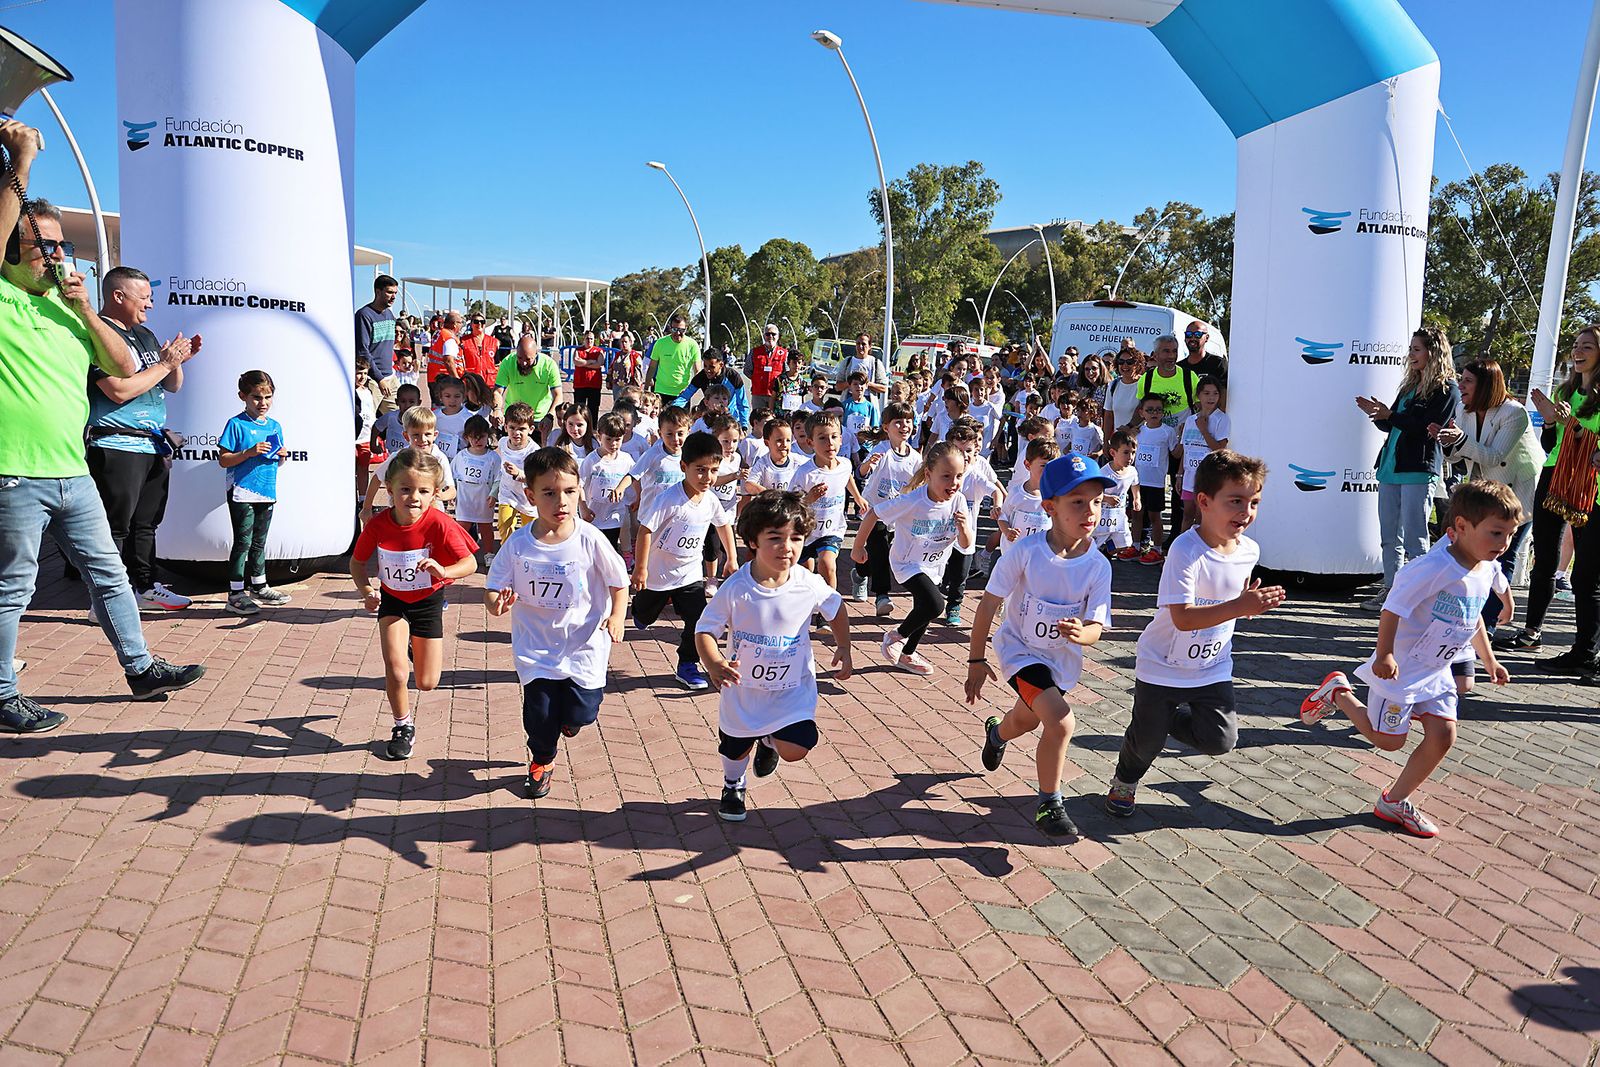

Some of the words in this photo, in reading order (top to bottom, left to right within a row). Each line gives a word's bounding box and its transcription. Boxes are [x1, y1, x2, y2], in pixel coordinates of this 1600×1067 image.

[165, 117, 244, 135] Fundación
[163, 133, 242, 150] ATLANTIC
[244, 138, 304, 161] COPPER
[169, 276, 247, 293] Fundación
[168, 292, 244, 307] ATLANTIC
[246, 295, 306, 313] COPPER
[1070, 323, 1098, 332] BANCO
[1100, 324, 1111, 332] DE
[1112, 325, 1162, 336] ALIMENTOS
[1102, 335, 1132, 343] HUEL
[1348, 353, 1401, 366] ATLANTIC
[1138, 453, 1152, 462] 033
[465, 466, 482, 479] 123
[714, 484, 733, 495] 092
[1341, 481, 1379, 493] ATLAN
[817, 519, 833, 531] 70
[1100, 517, 1117, 528] 004
[677, 536, 700, 550] 093
[385, 566, 416, 582] 143
[529, 580, 564, 599] 177
[1035, 621, 1061, 640] 05
[1188, 641, 1222, 659] 059
[1436, 644, 1459, 660] 16
[751, 664, 791, 681] 057
